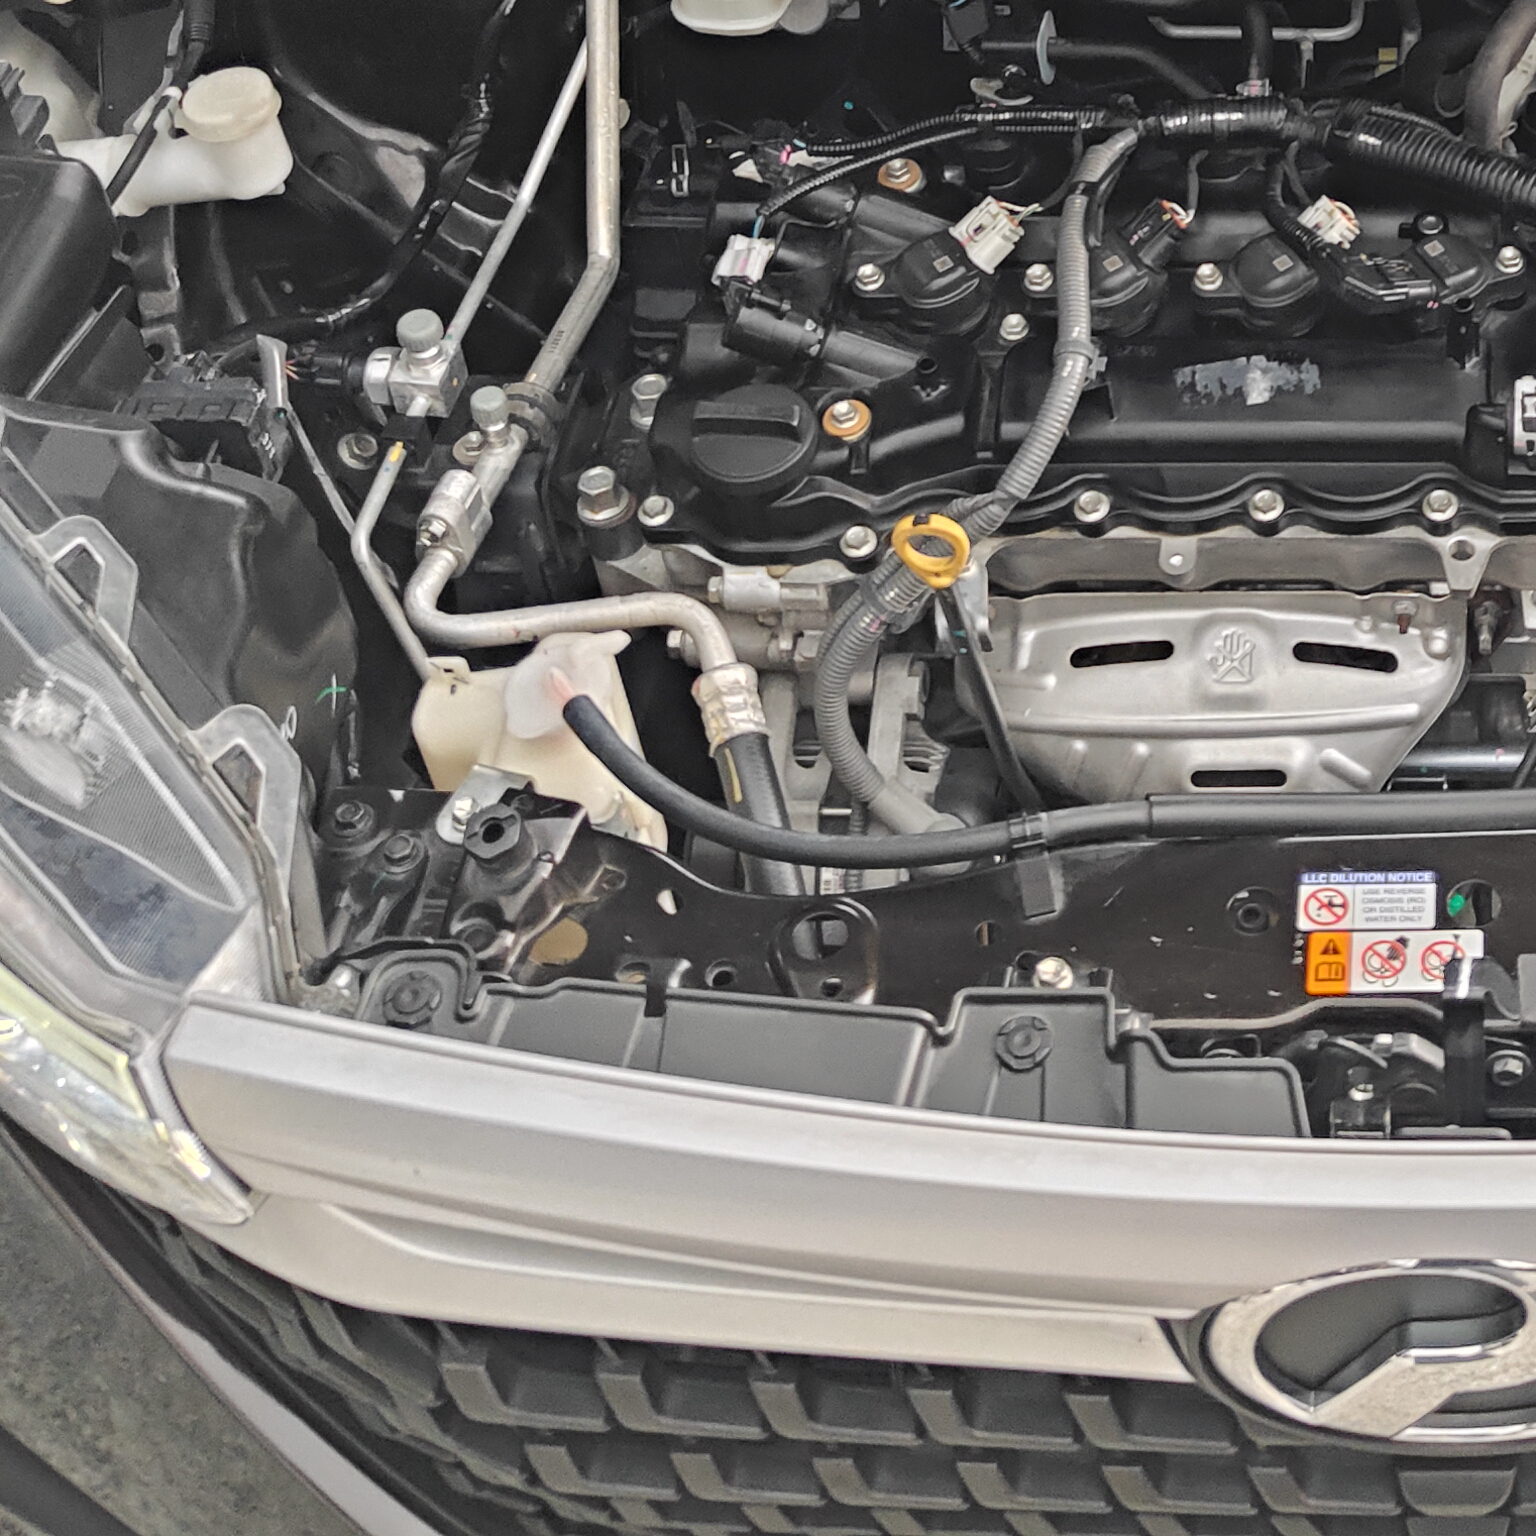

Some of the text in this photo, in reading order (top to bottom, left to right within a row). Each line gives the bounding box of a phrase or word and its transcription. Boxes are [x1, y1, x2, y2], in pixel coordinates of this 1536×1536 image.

[1304, 872, 1433, 883] LLC DILUTION NOTICE
